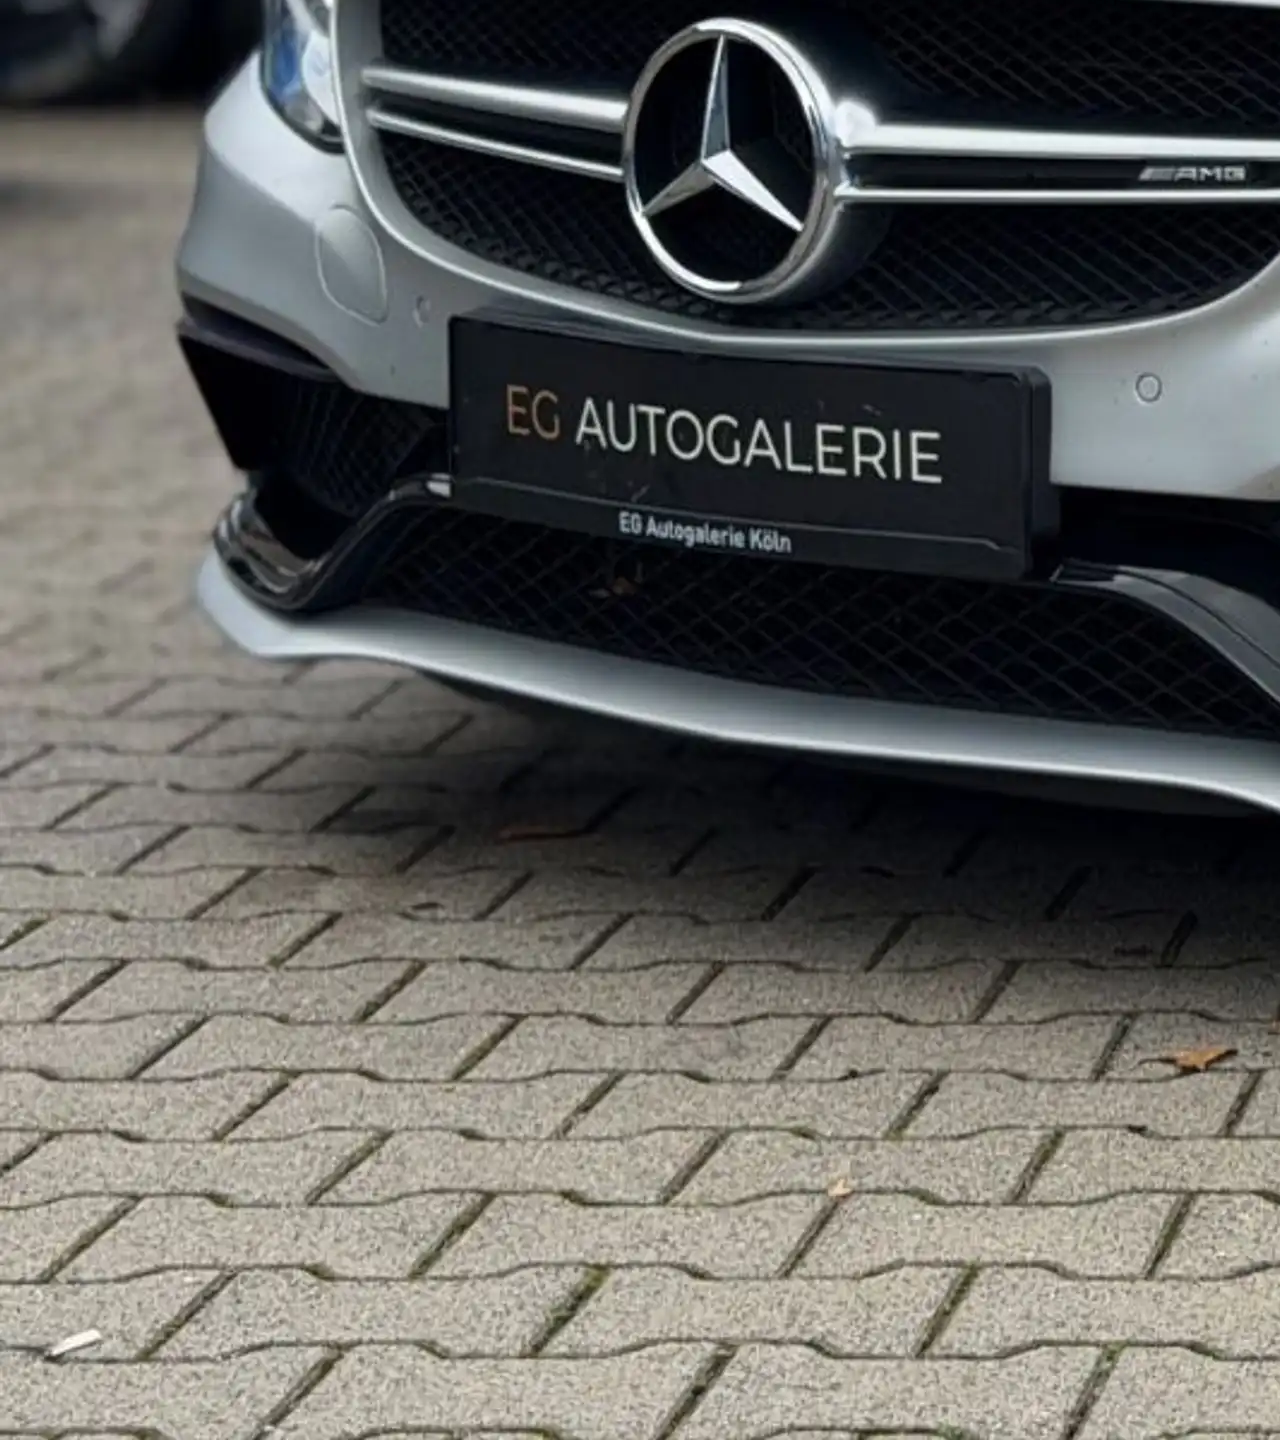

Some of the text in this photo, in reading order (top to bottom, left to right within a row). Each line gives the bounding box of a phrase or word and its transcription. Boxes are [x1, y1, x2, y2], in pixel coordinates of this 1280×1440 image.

[1172, 165, 1248, 182] AMG
[505, 383, 943, 485] EG AUTOGALERIE
[617, 511, 793, 554] EG Autogalerie Köln
